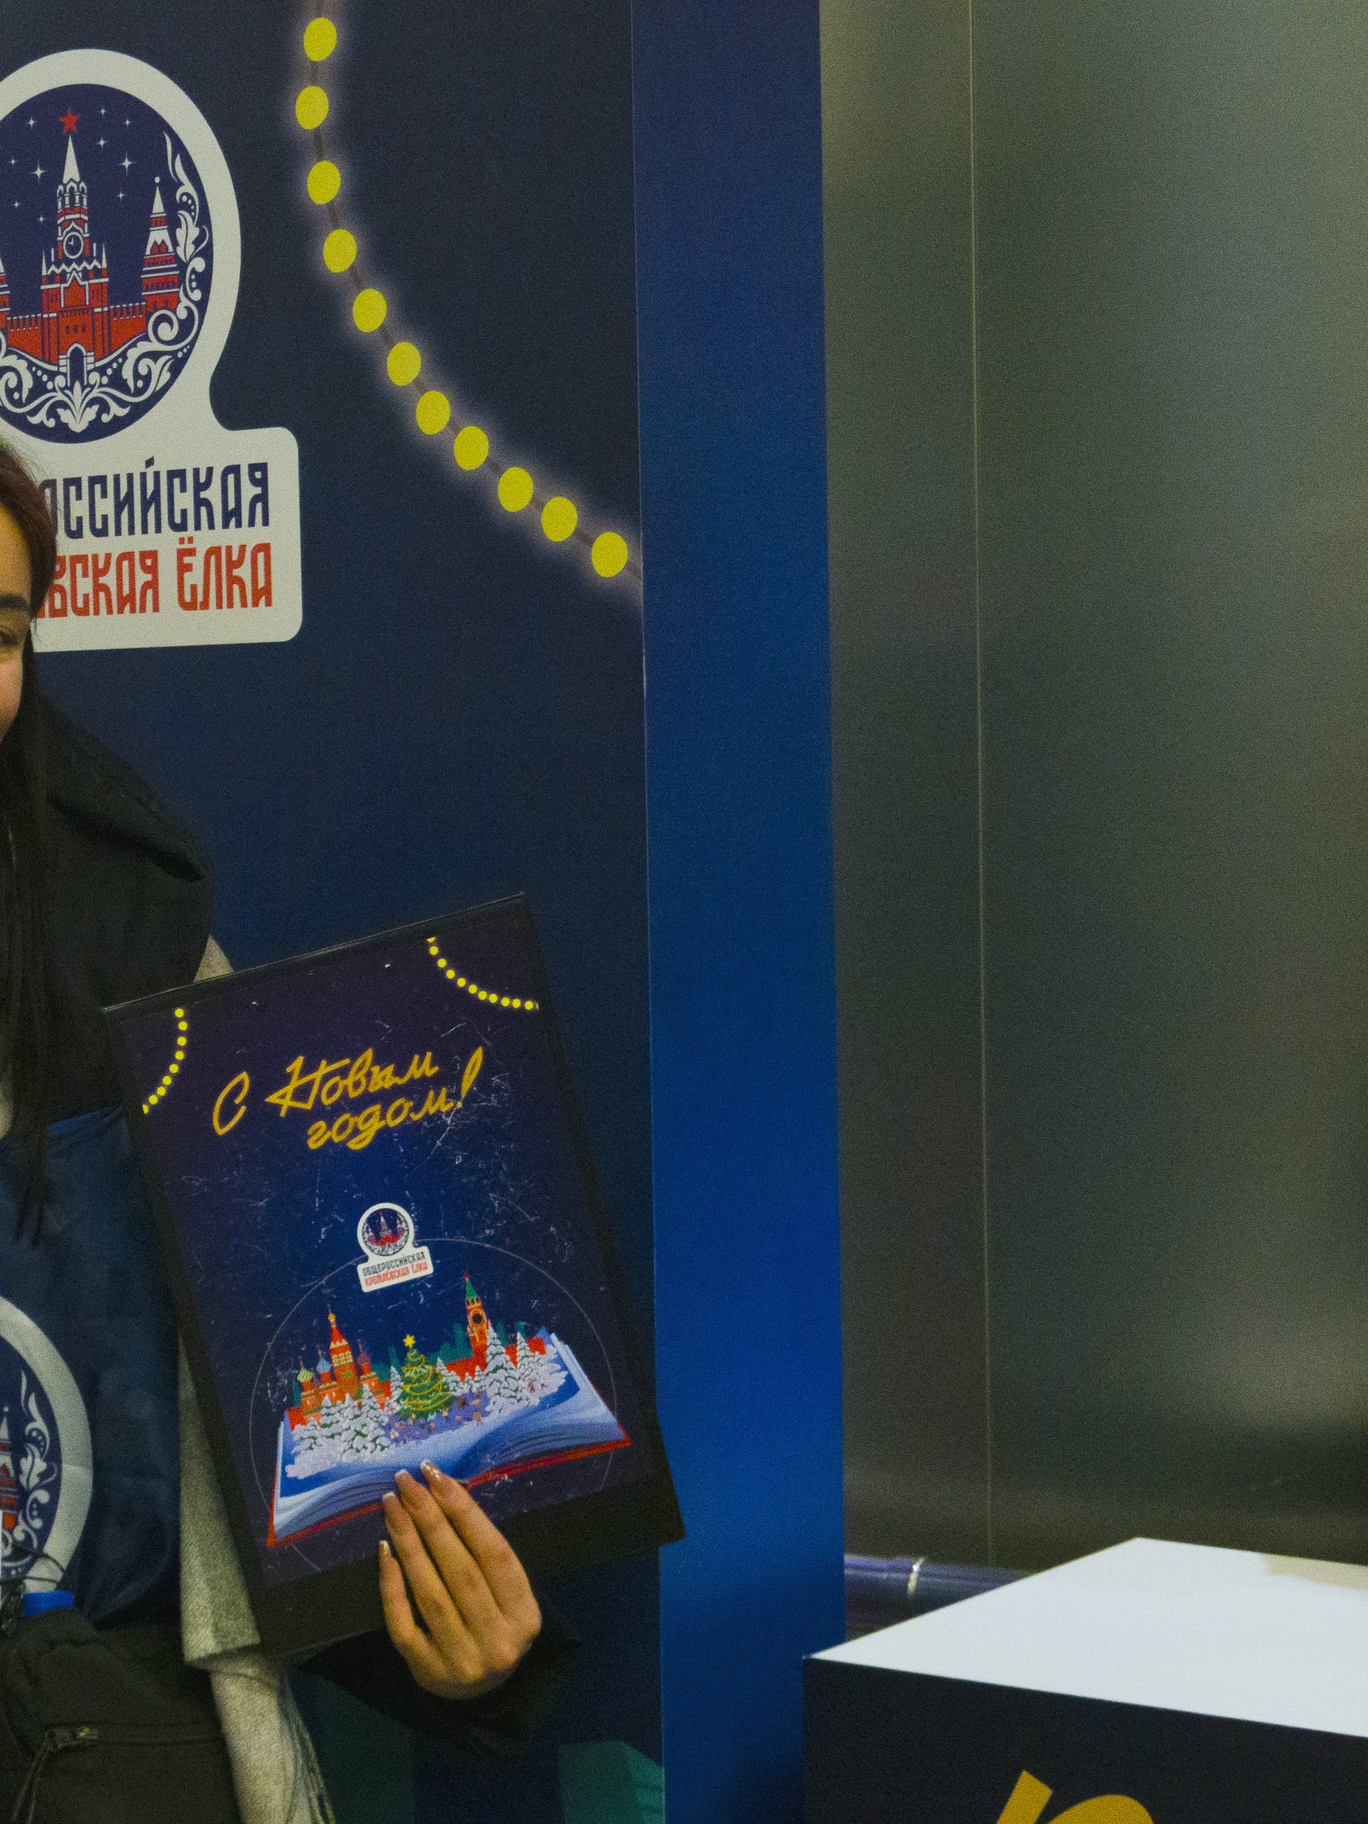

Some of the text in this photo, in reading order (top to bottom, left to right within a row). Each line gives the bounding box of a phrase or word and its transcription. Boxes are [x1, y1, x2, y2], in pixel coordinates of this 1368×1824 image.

[36, 536, 273, 619] ВСКАЯ ЁЛКА
[212, 1047, 439, 1135] С Новым
[307, 1046, 482, 1150] годом!
